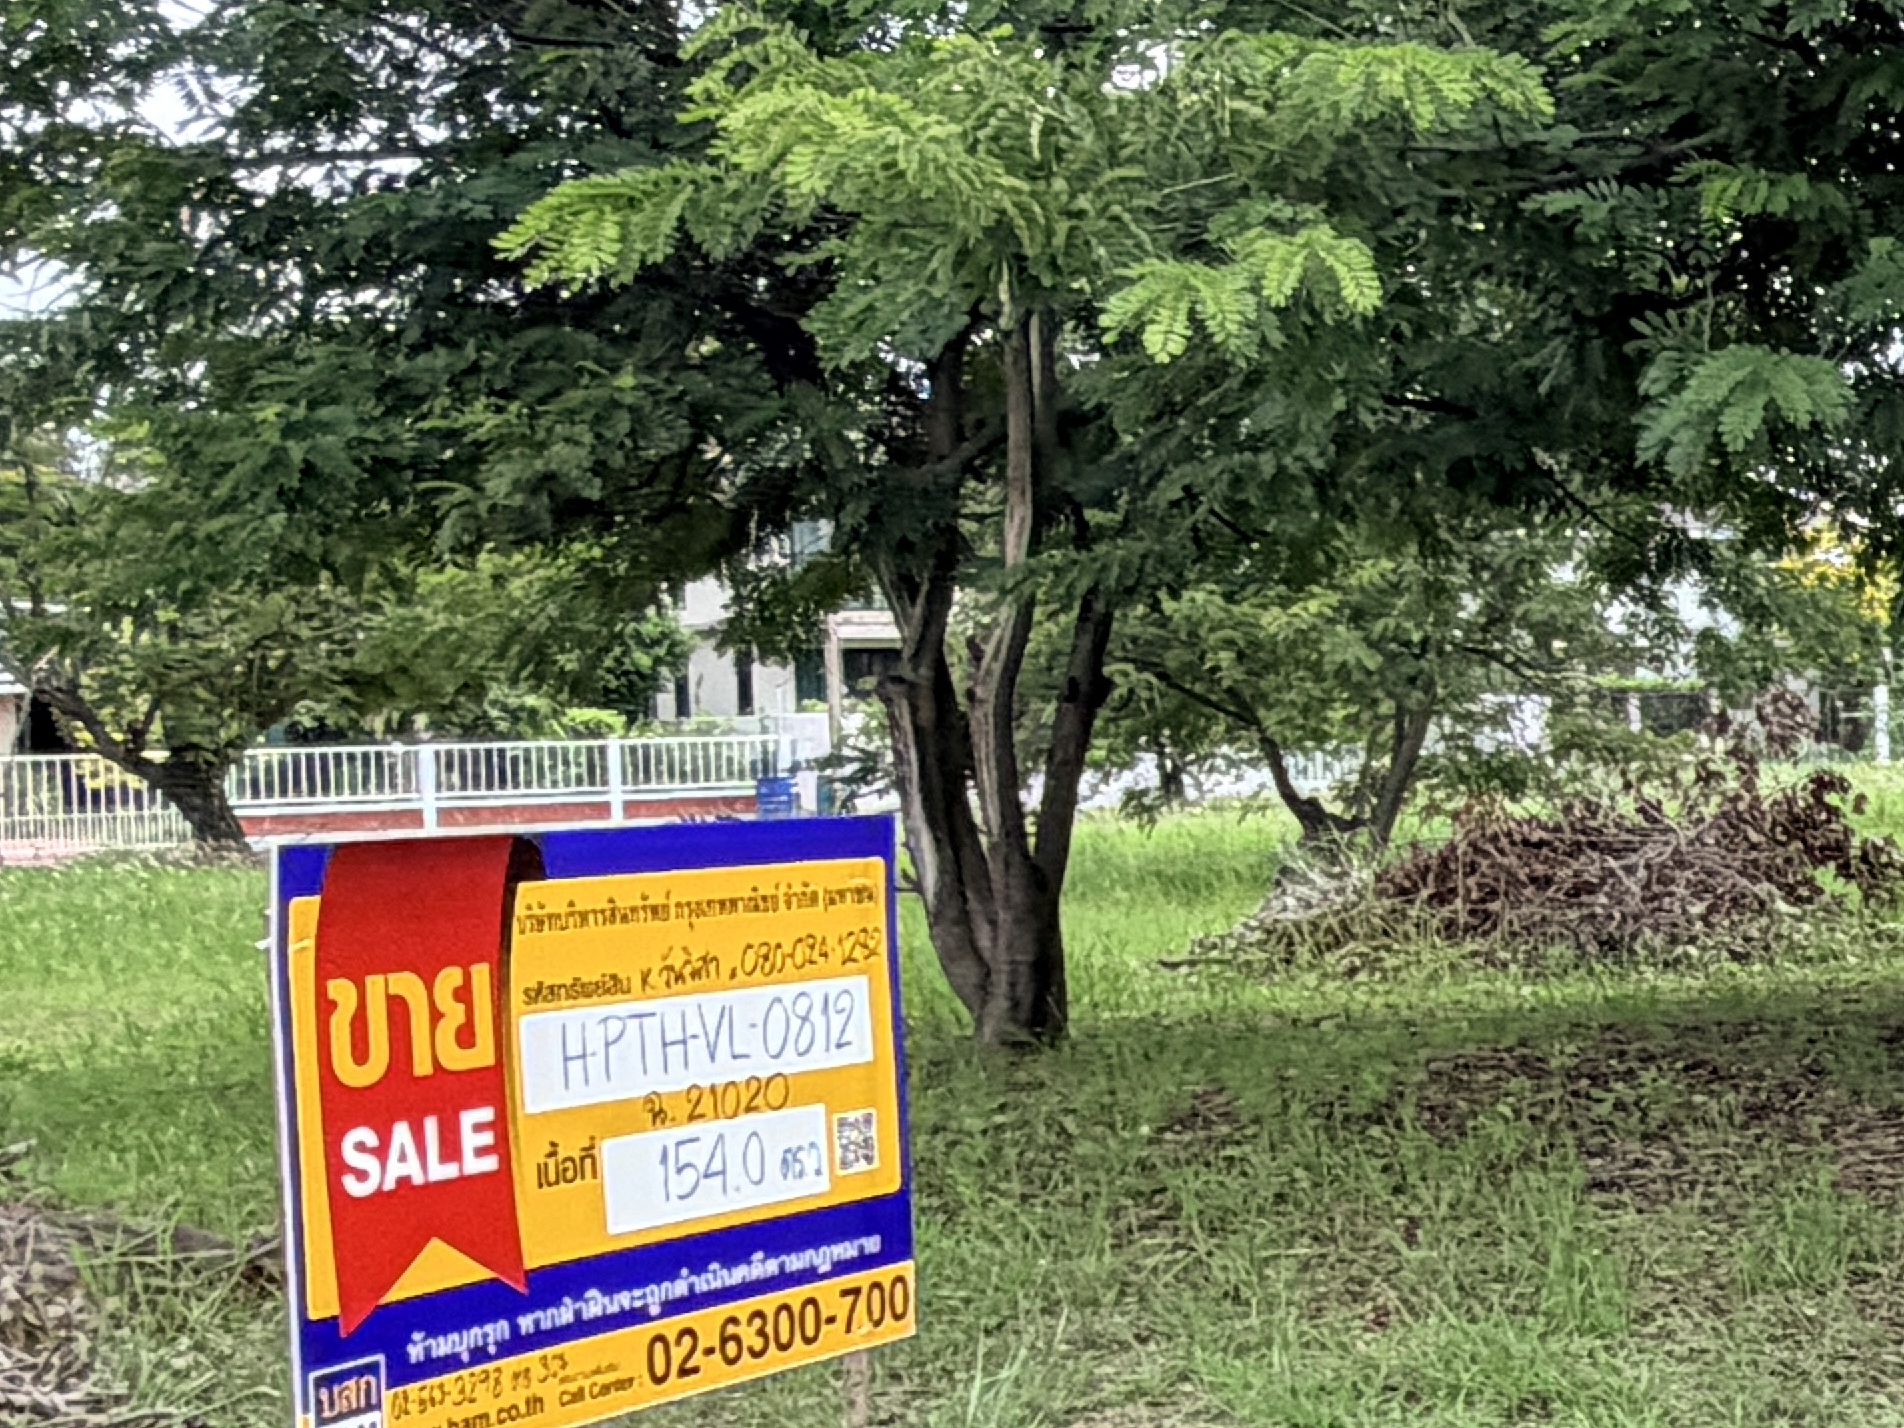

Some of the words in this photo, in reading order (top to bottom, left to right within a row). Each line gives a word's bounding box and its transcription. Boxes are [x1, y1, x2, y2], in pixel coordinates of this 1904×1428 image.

[326, 962, 495, 1088] ขาย
[341, 1105, 499, 1198] SALE
[536, 1136, 598, 1189] เนื้อที่
[659, 1131, 766, 1202] 154.0
[646, 1275, 911, 1385] 02-6300-700
[319, 1374, 377, 1418] บสก
